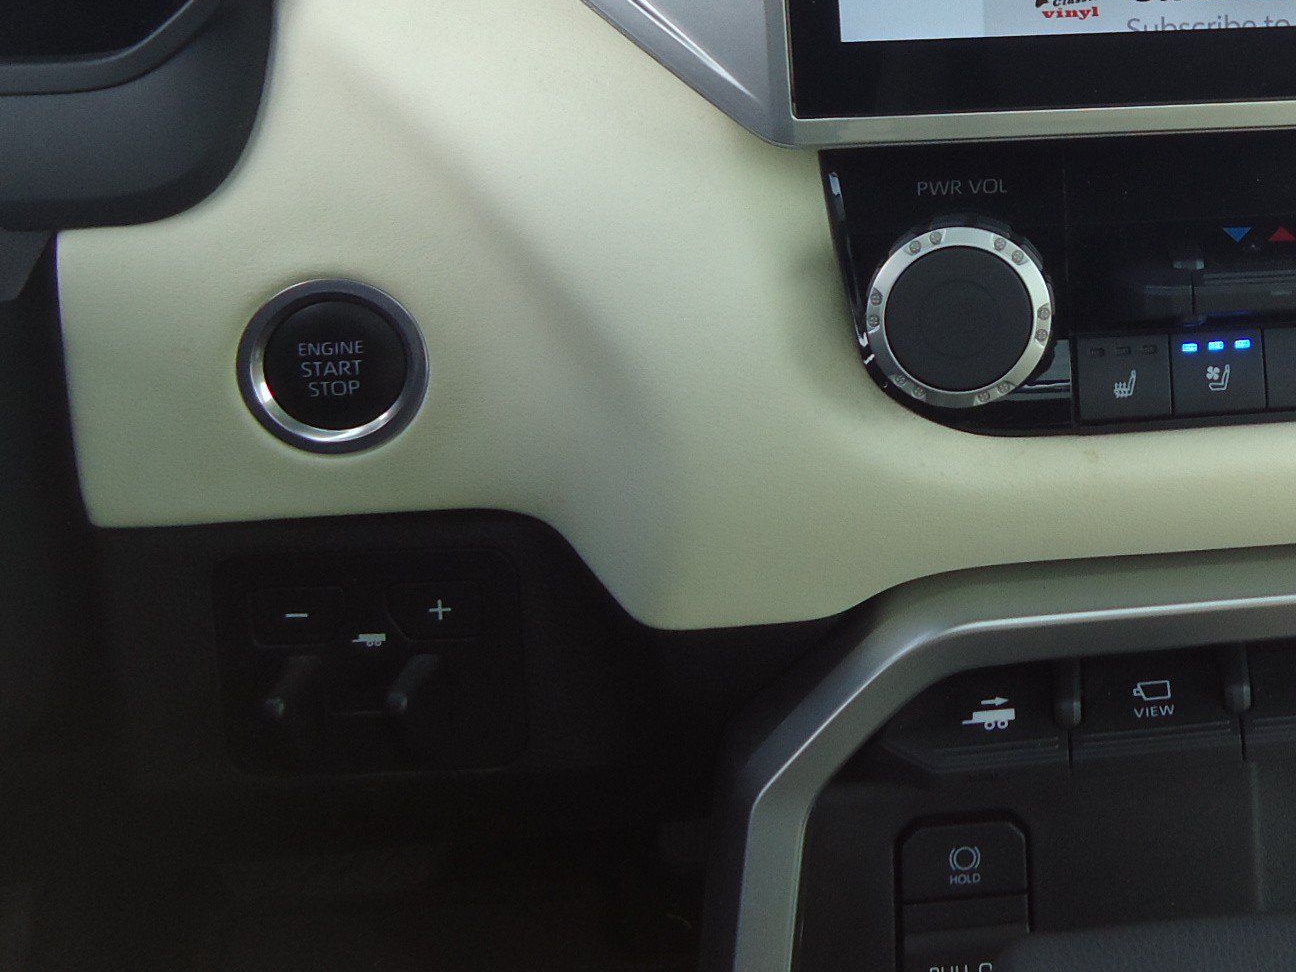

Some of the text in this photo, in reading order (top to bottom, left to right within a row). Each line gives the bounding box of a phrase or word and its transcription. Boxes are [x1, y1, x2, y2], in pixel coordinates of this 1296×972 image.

[1042, 6, 1100, 20] vinyl
[916, 178, 1008, 196] PWR VOL
[298, 340, 363, 357] ENGINE
[301, 360, 362, 378] START
[308, 381, 360, 397] STOP
[1134, 704, 1175, 718] VIEW
[949, 874, 981, 884] HOLD
